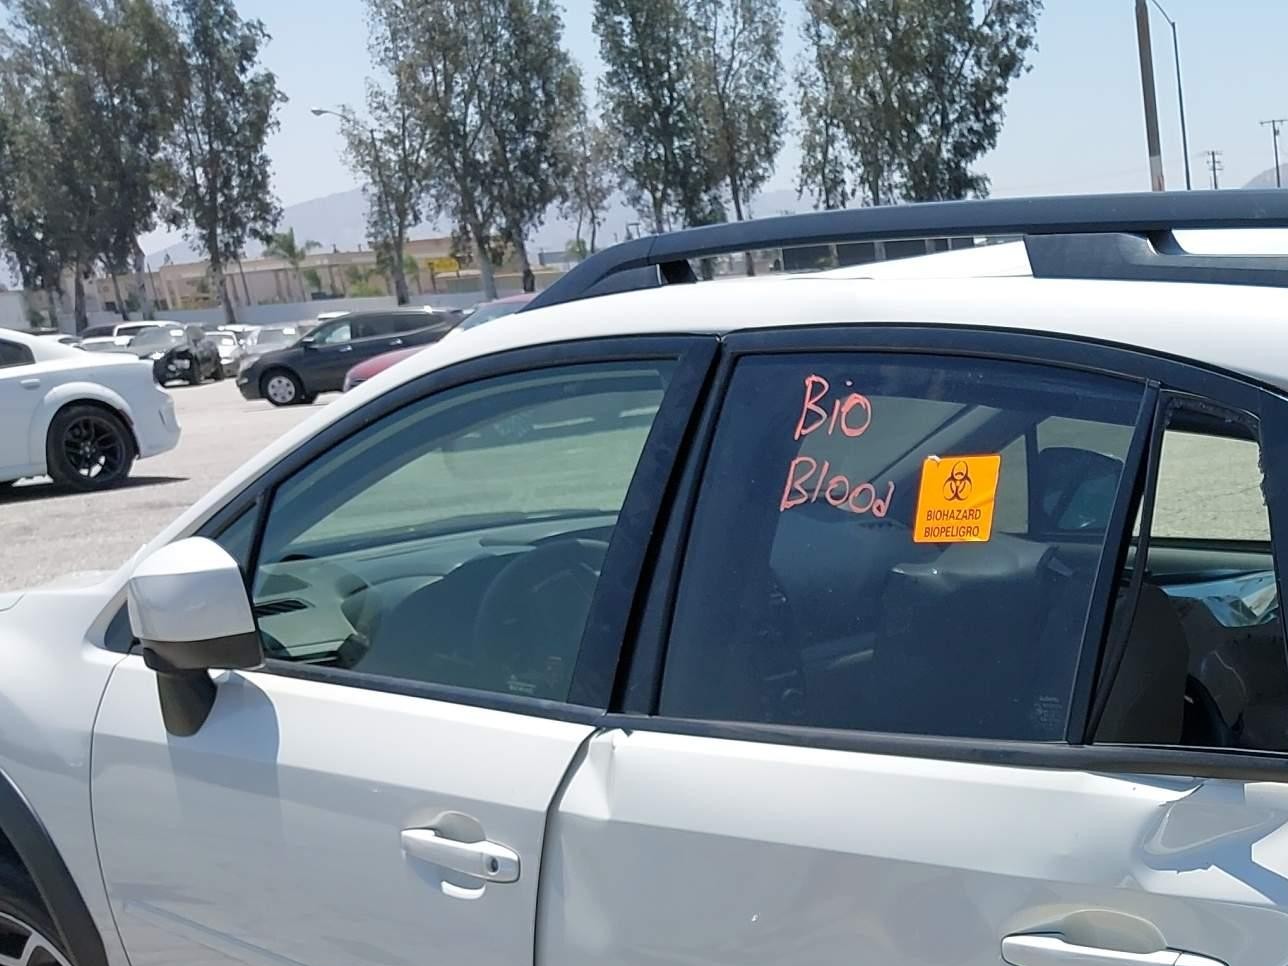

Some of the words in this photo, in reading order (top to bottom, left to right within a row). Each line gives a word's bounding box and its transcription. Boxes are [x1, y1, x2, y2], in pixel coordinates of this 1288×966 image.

[780, 456, 895, 518] Blood
[926, 508, 982, 521] BIOHAZARD
[924, 525, 980, 538] BIOPELIGRO
